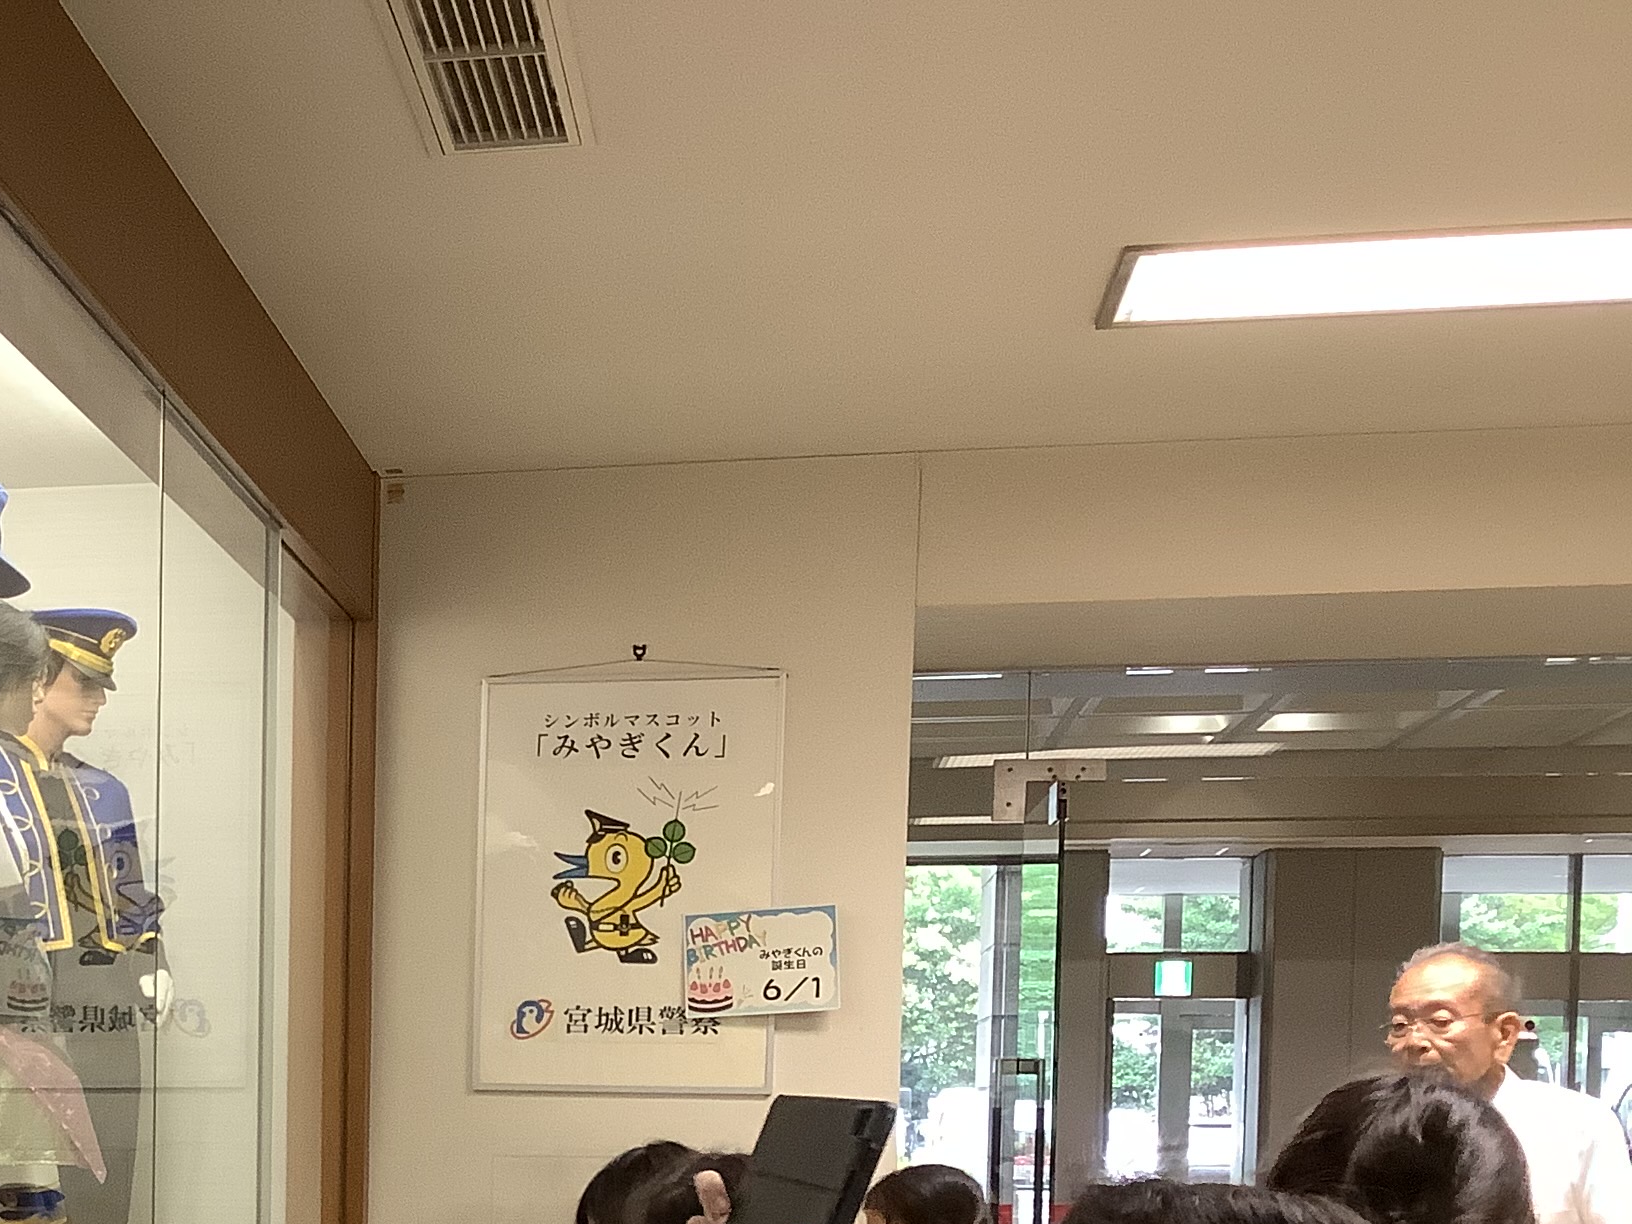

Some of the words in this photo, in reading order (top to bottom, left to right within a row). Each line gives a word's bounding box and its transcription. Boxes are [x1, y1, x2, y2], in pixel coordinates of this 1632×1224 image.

[544, 710, 721, 729] シンボルマスコット
[536, 732, 727, 760] 「みやぎくん」
[689, 913, 753, 946] HAPPY
[686, 929, 768, 967] BIRTHDAY
[758, 946, 824, 961] みやぎくんの
[771, 959, 807, 972] 誕生日
[763, 976, 822, 1002] 6/1
